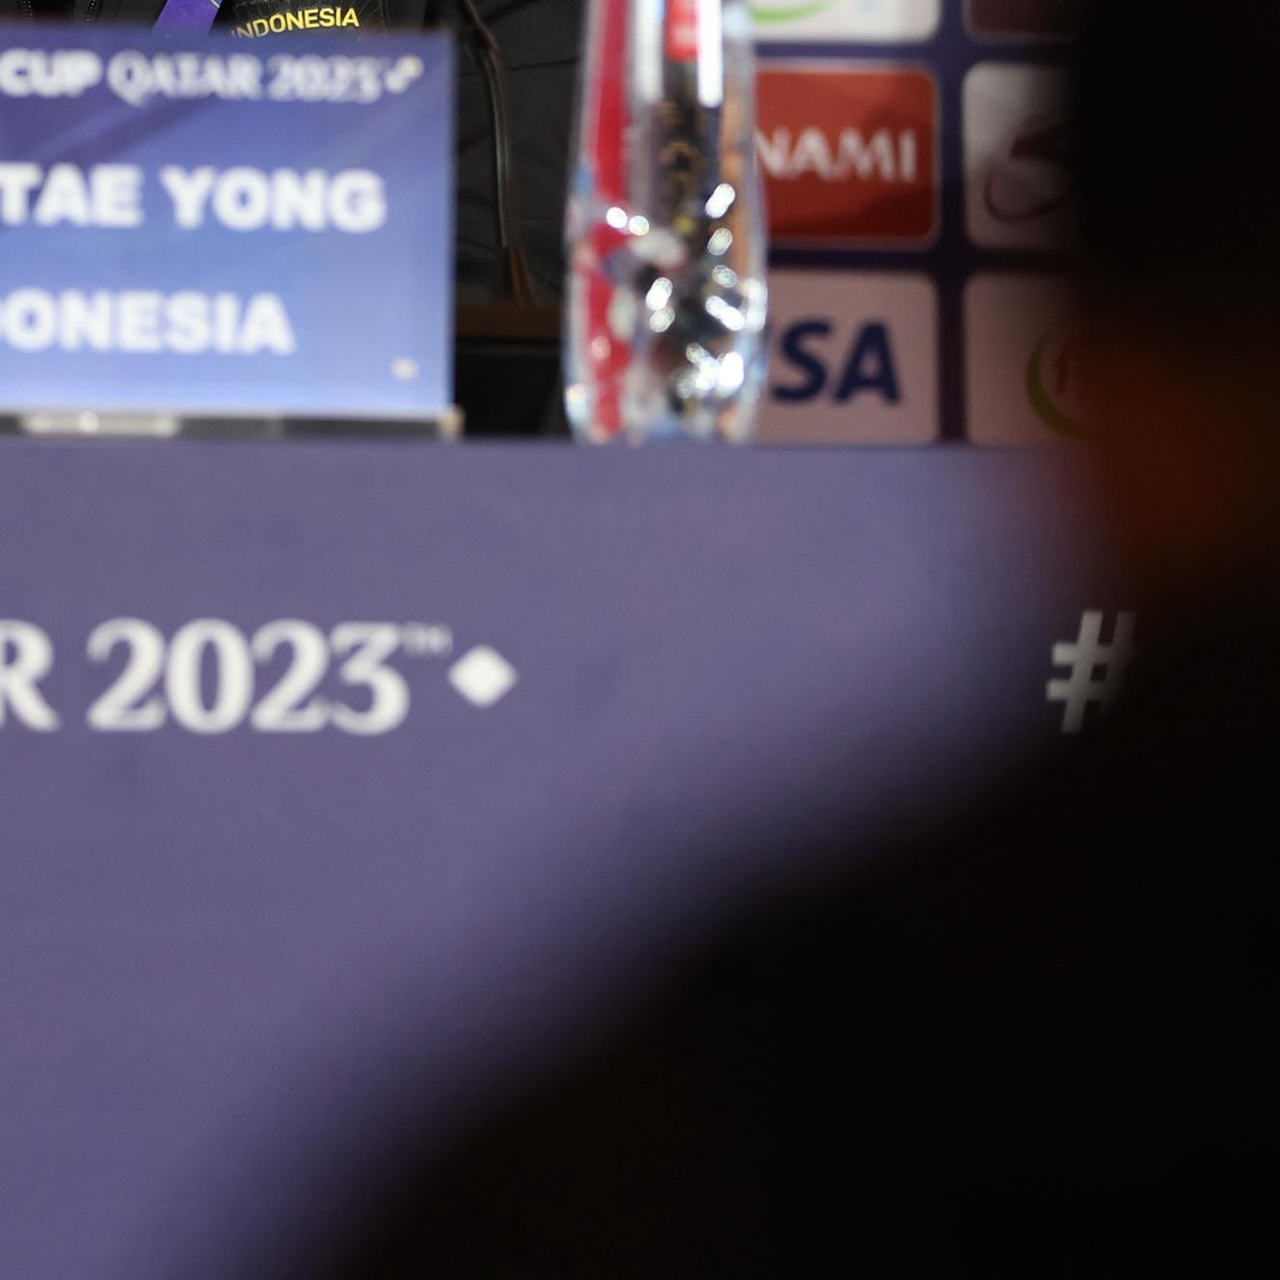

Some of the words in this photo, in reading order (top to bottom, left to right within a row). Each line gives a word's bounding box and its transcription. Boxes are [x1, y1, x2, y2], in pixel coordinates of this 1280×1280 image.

[231, 7, 360, 39] NDONESIA
[106, 50, 262, 106] QATAR
[755, 126, 918, 184] NAMI
[160, 164, 390, 233] YONG
[773, 319, 902, 406] SA
[84, 616, 411, 735] 2023
